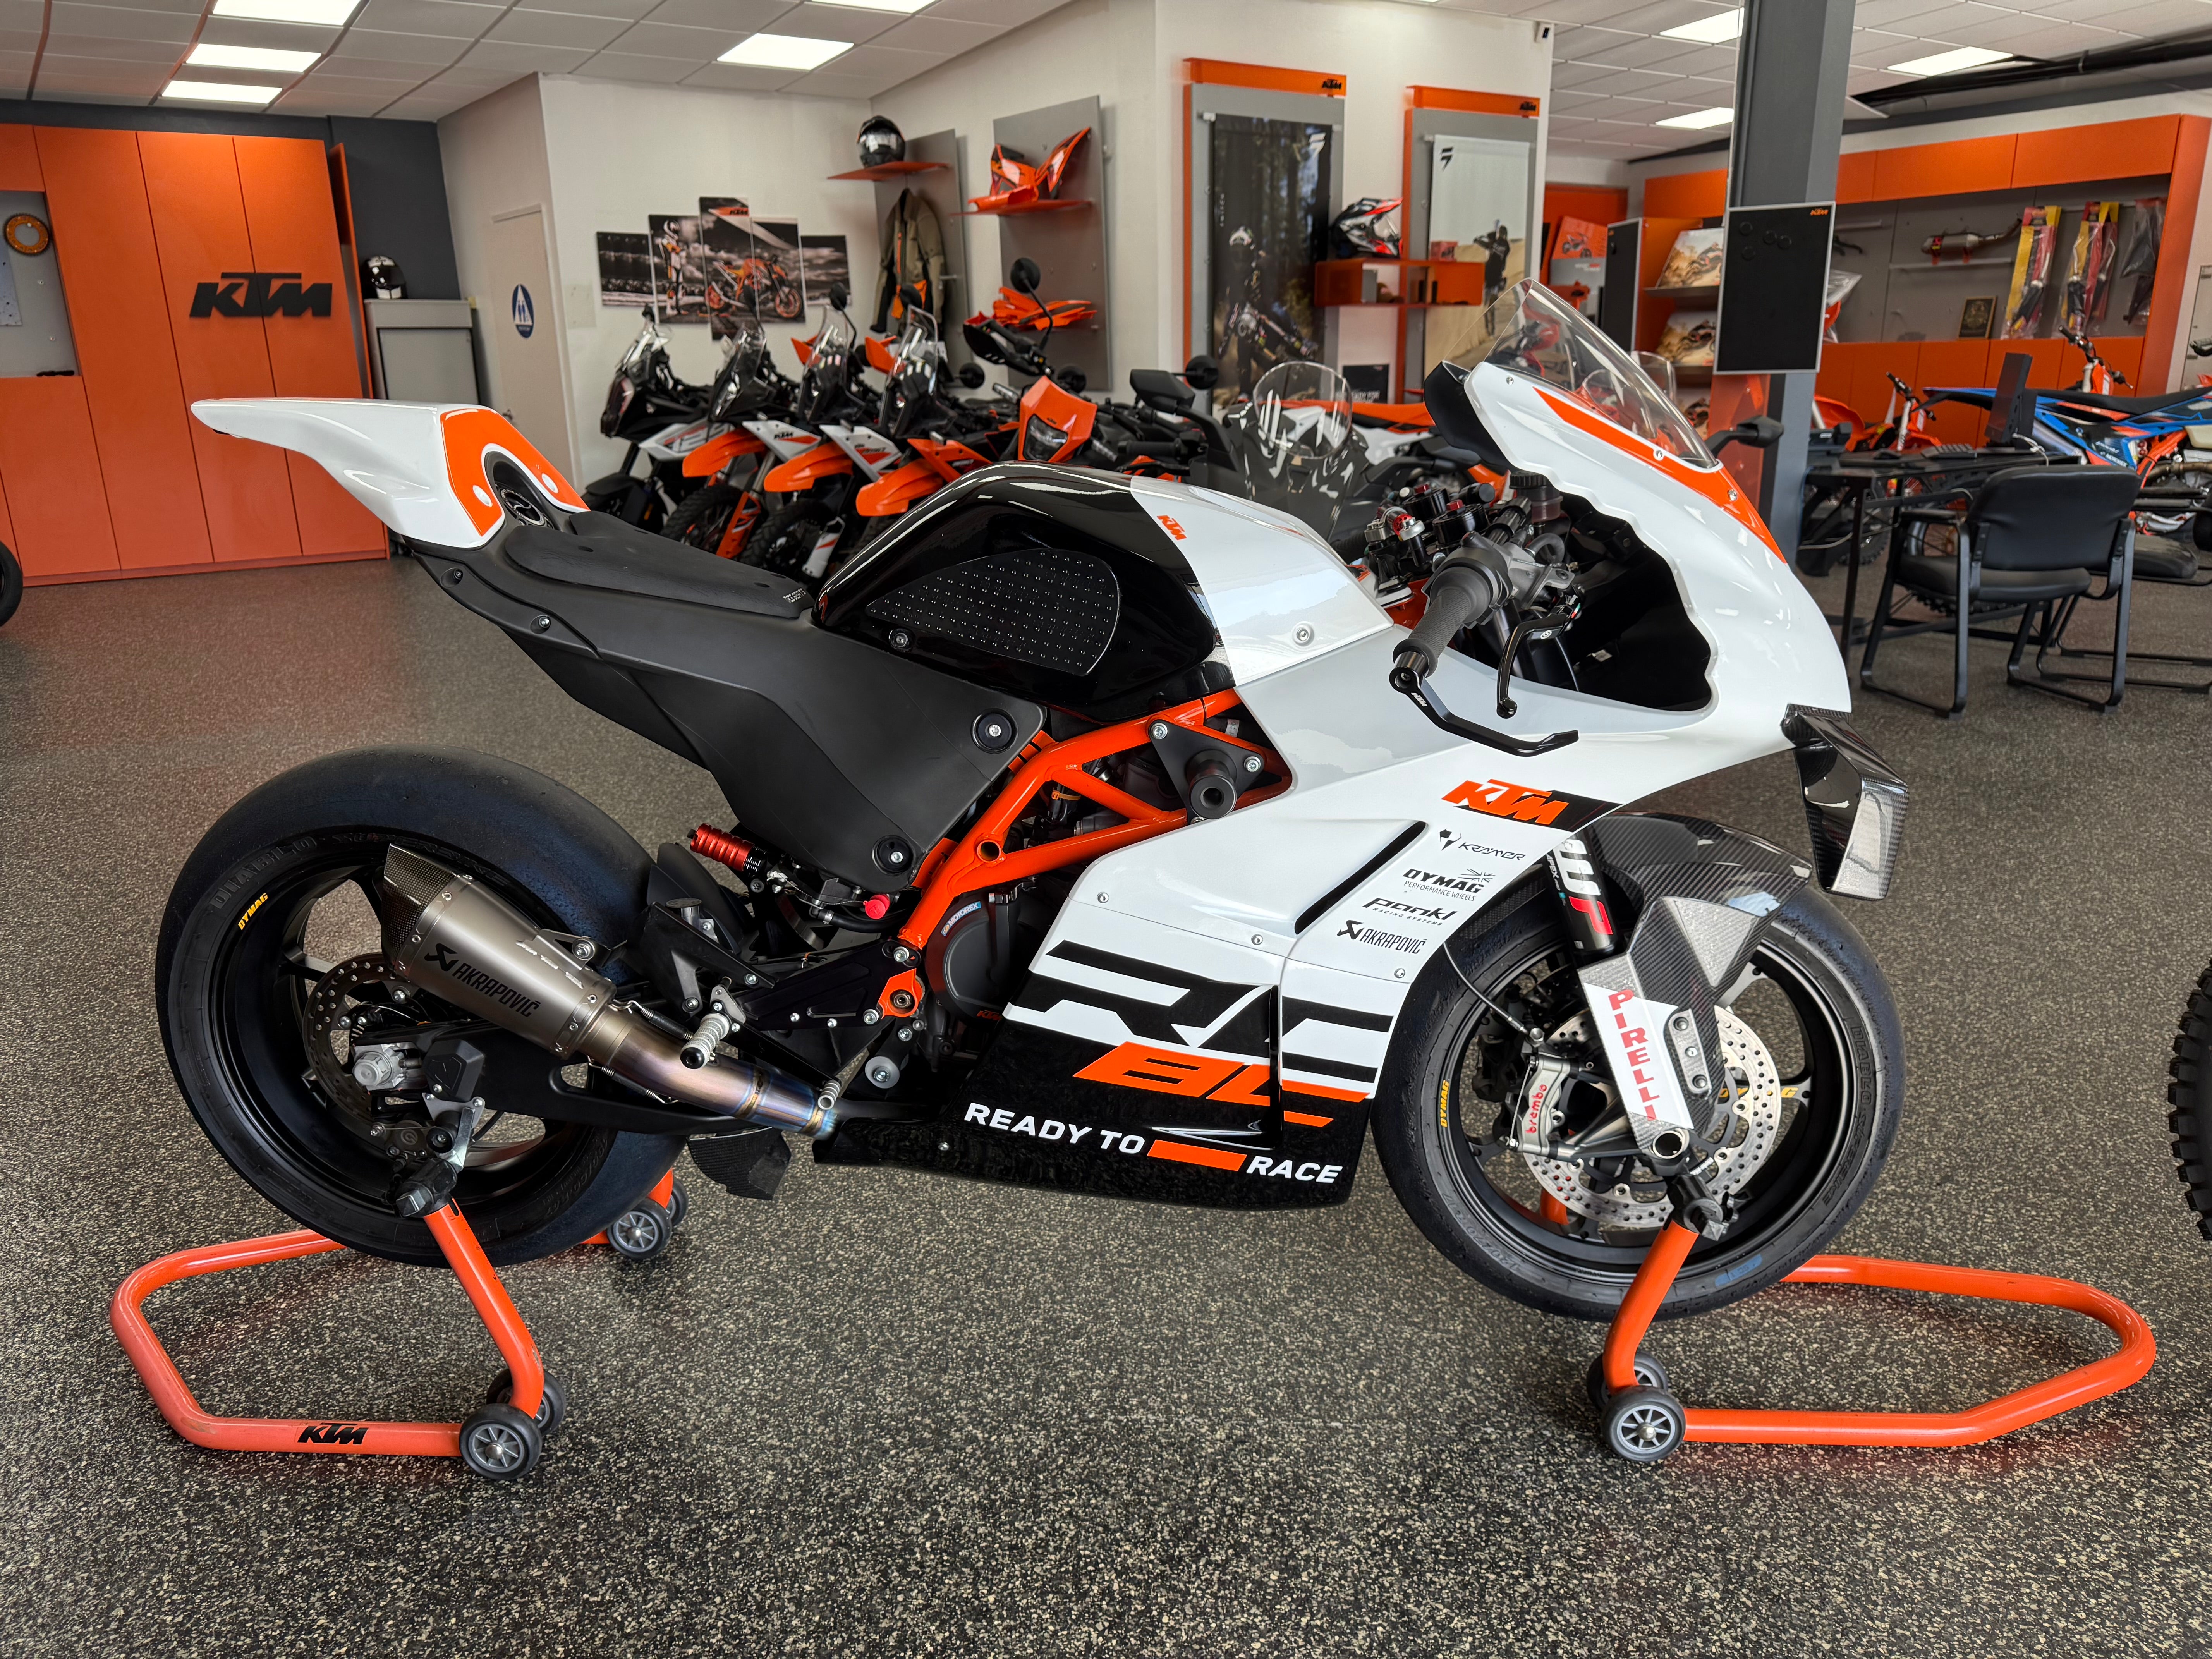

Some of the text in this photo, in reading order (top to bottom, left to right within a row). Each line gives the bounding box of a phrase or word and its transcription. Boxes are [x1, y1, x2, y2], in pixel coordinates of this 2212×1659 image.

[1322, 79, 1342, 89] KTM
[1520, 101, 1536, 112] KTM
[190, 272, 332, 317] KTM
[1156, 515, 1187, 541] KTM
[1411, 692, 1429, 707] KTM
[1441, 779, 1568, 825] KTM
[209, 835, 317, 909] DIABLO
[1546, 854, 1559, 879] APEX
[1402, 869, 1485, 893] DYMAG
[1404, 881, 1476, 902] PERFORMANCE WHEELS
[238, 892, 268, 931] DYMAG
[948, 903, 979, 927] MOTOREX
[1362, 898, 1458, 920] pankl
[1372, 907, 1443, 926] RACING SYSTEMS
[1608, 989, 1657, 1121] PIRELLI
[1851, 1025, 1872, 1105] DIABLO
[1440, 1079, 1449, 1128] DYMAG
[1719, 1087, 1798, 1098] DYG
[1525, 1084, 1547, 1134] brembo
[964, 1103, 1343, 1184] READY TO RACE
[297, 1423, 369, 1445] KTM
